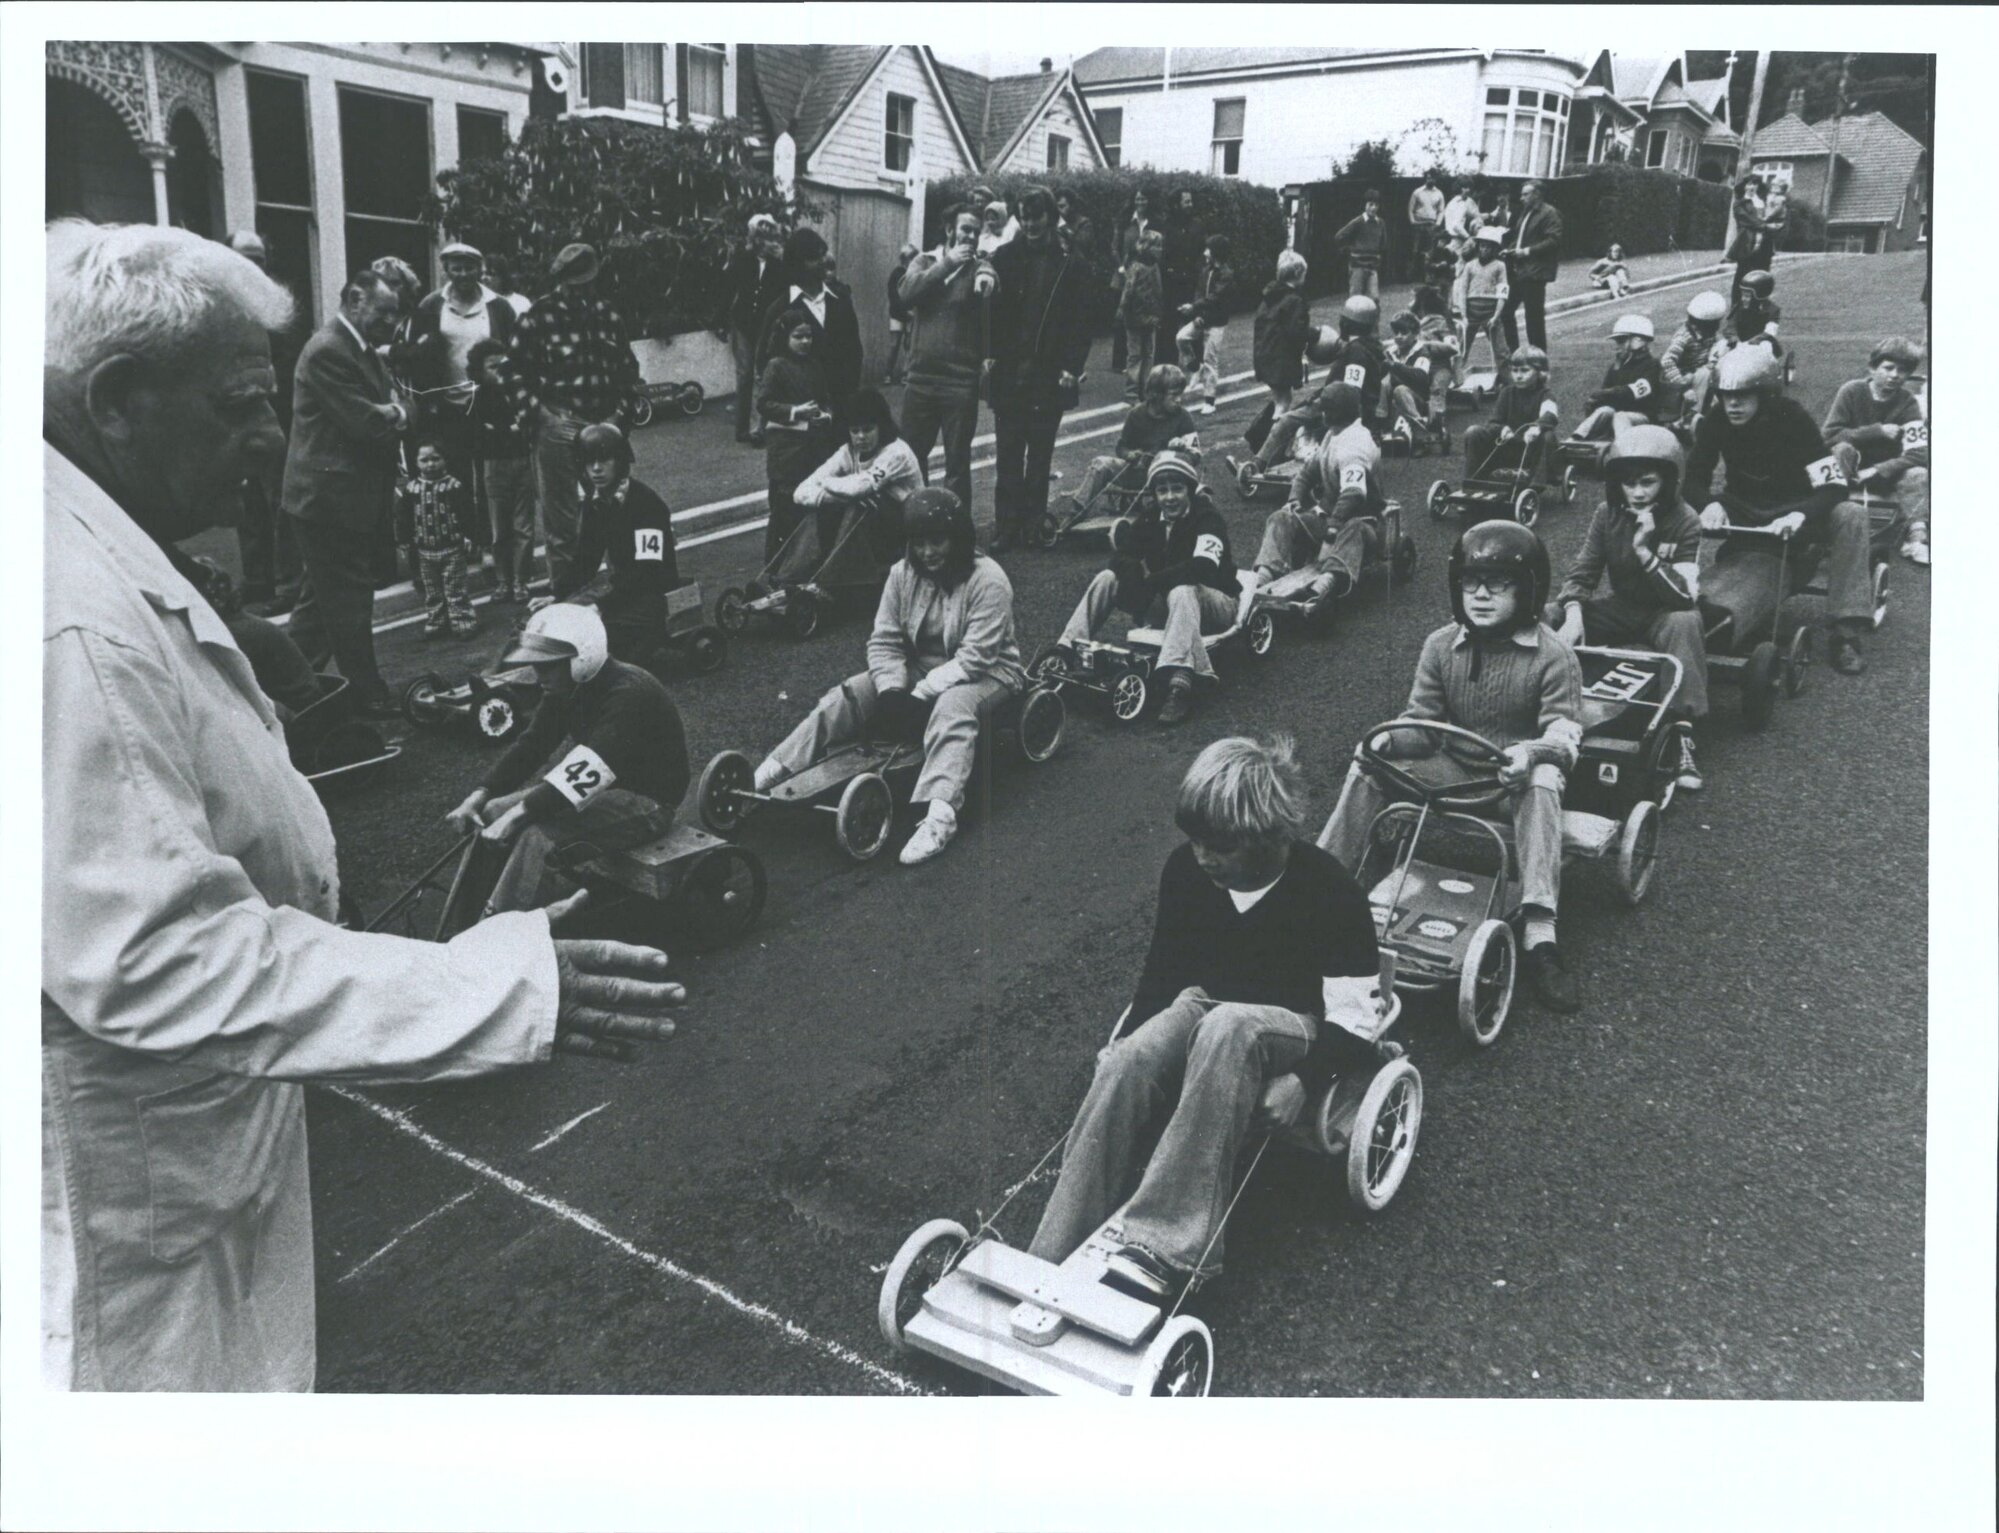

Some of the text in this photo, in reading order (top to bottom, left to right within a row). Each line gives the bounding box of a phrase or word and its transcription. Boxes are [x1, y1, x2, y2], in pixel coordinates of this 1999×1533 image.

[1345, 469, 1364, 483] 27
[641, 534, 660, 553] 14
[564, 760, 601, 798] 42
